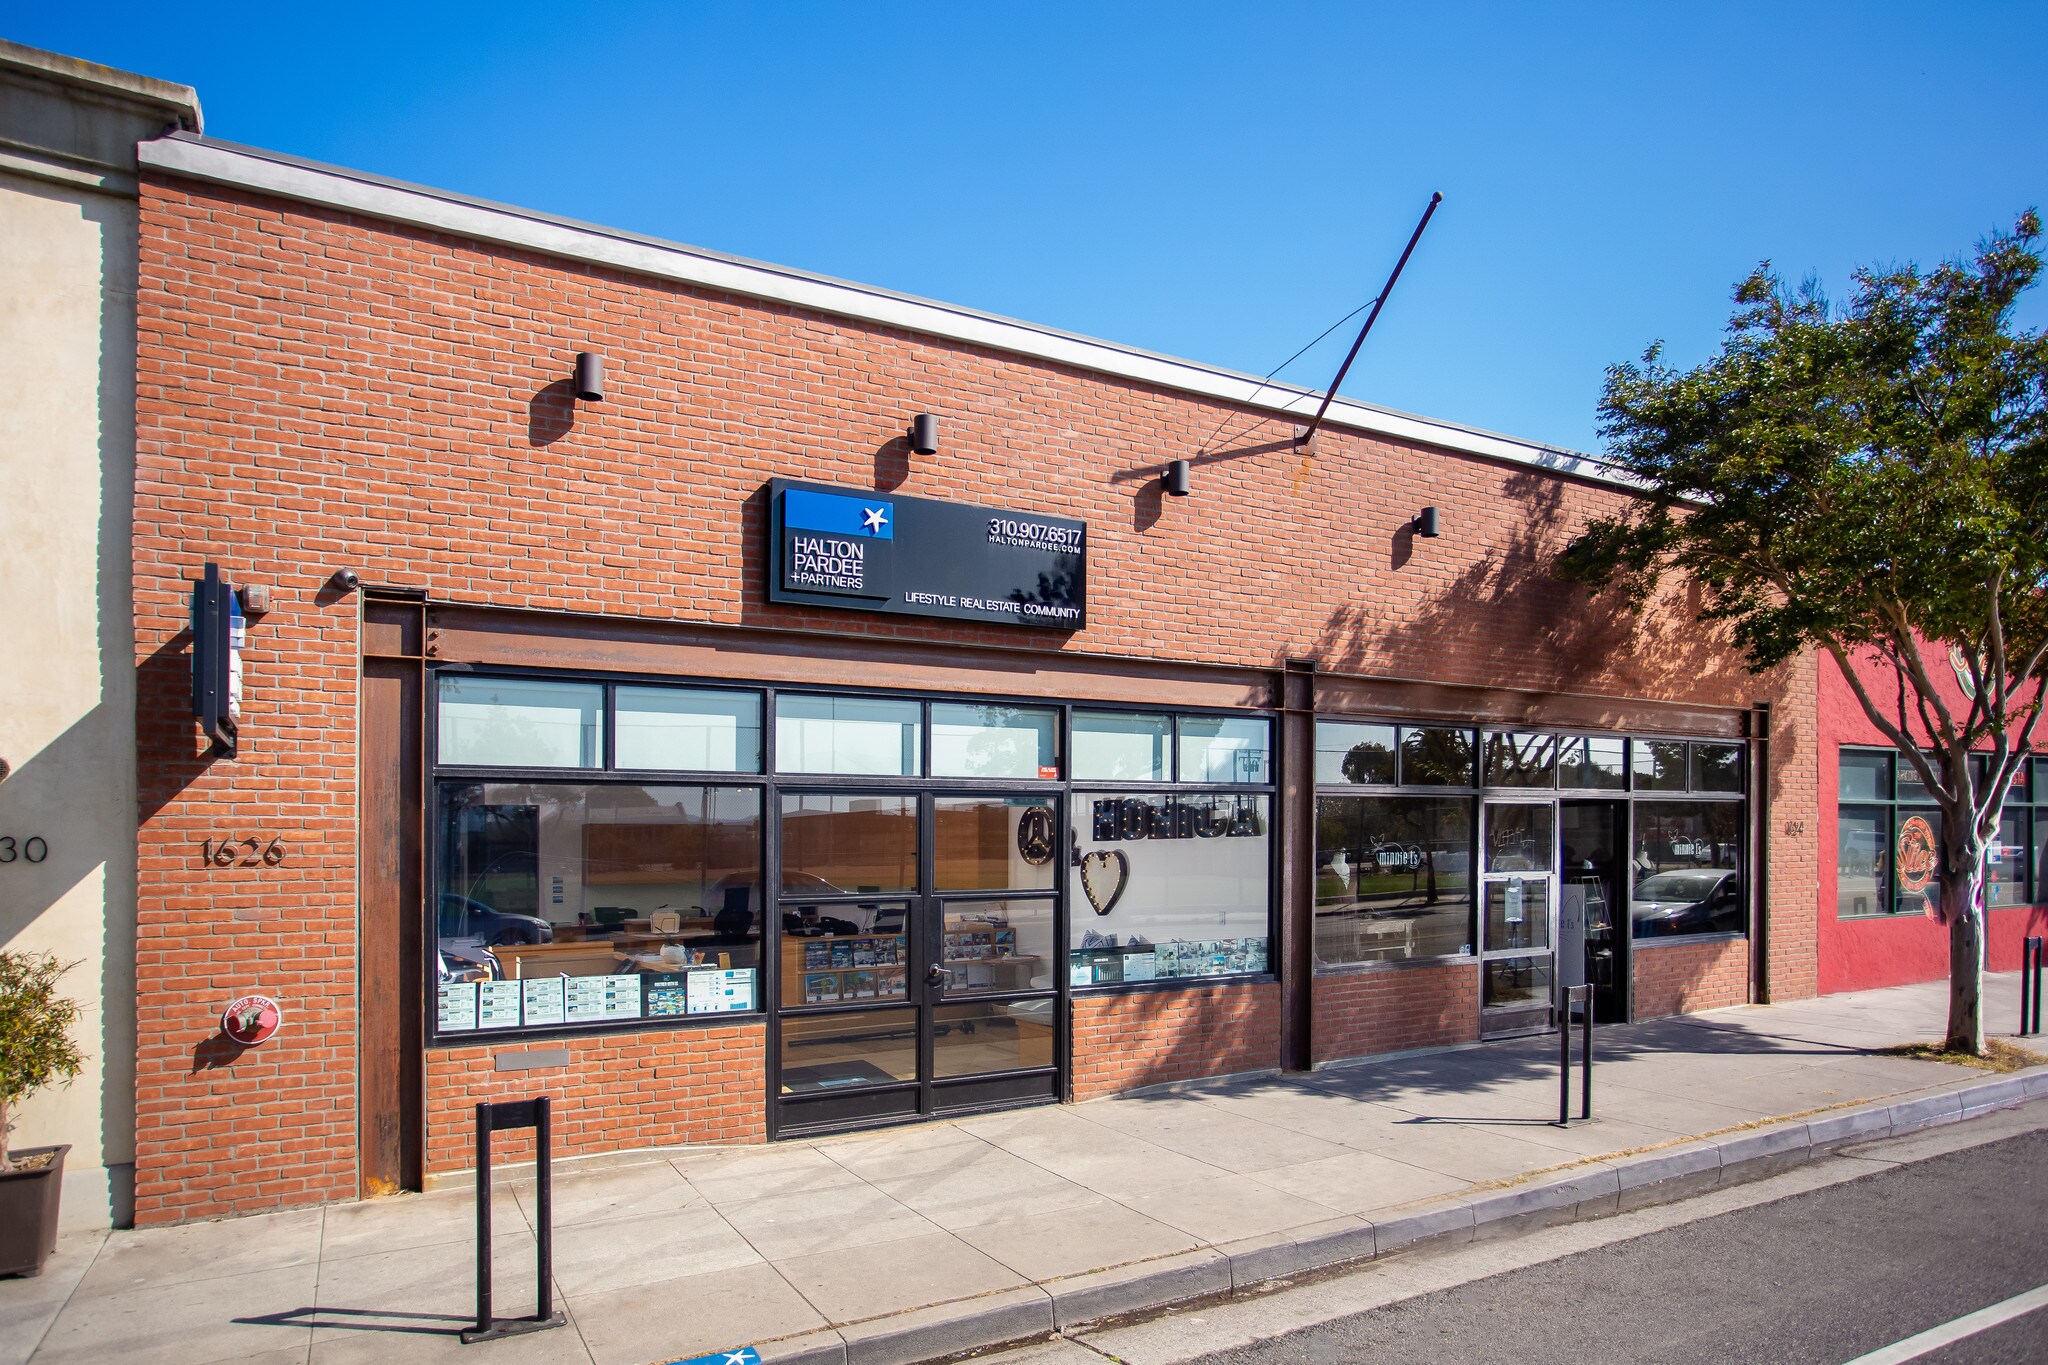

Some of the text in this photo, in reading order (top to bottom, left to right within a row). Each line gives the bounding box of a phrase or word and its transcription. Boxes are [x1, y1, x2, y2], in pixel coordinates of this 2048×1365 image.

[990, 518, 1082, 545] 310.907.6517
[794, 536, 864, 560] HALTON
[988, 534, 1081, 554] HALTONPARDEE.COM
[794, 553, 864, 577] PARDEE
[790, 571, 863, 589] +PARTNERS
[905, 592, 1081, 619] LIFESTYLE REAL ESTATE COMMUNITY
[201, 835, 288, 868] 1626
[1379, 851, 1408, 866] minnie
